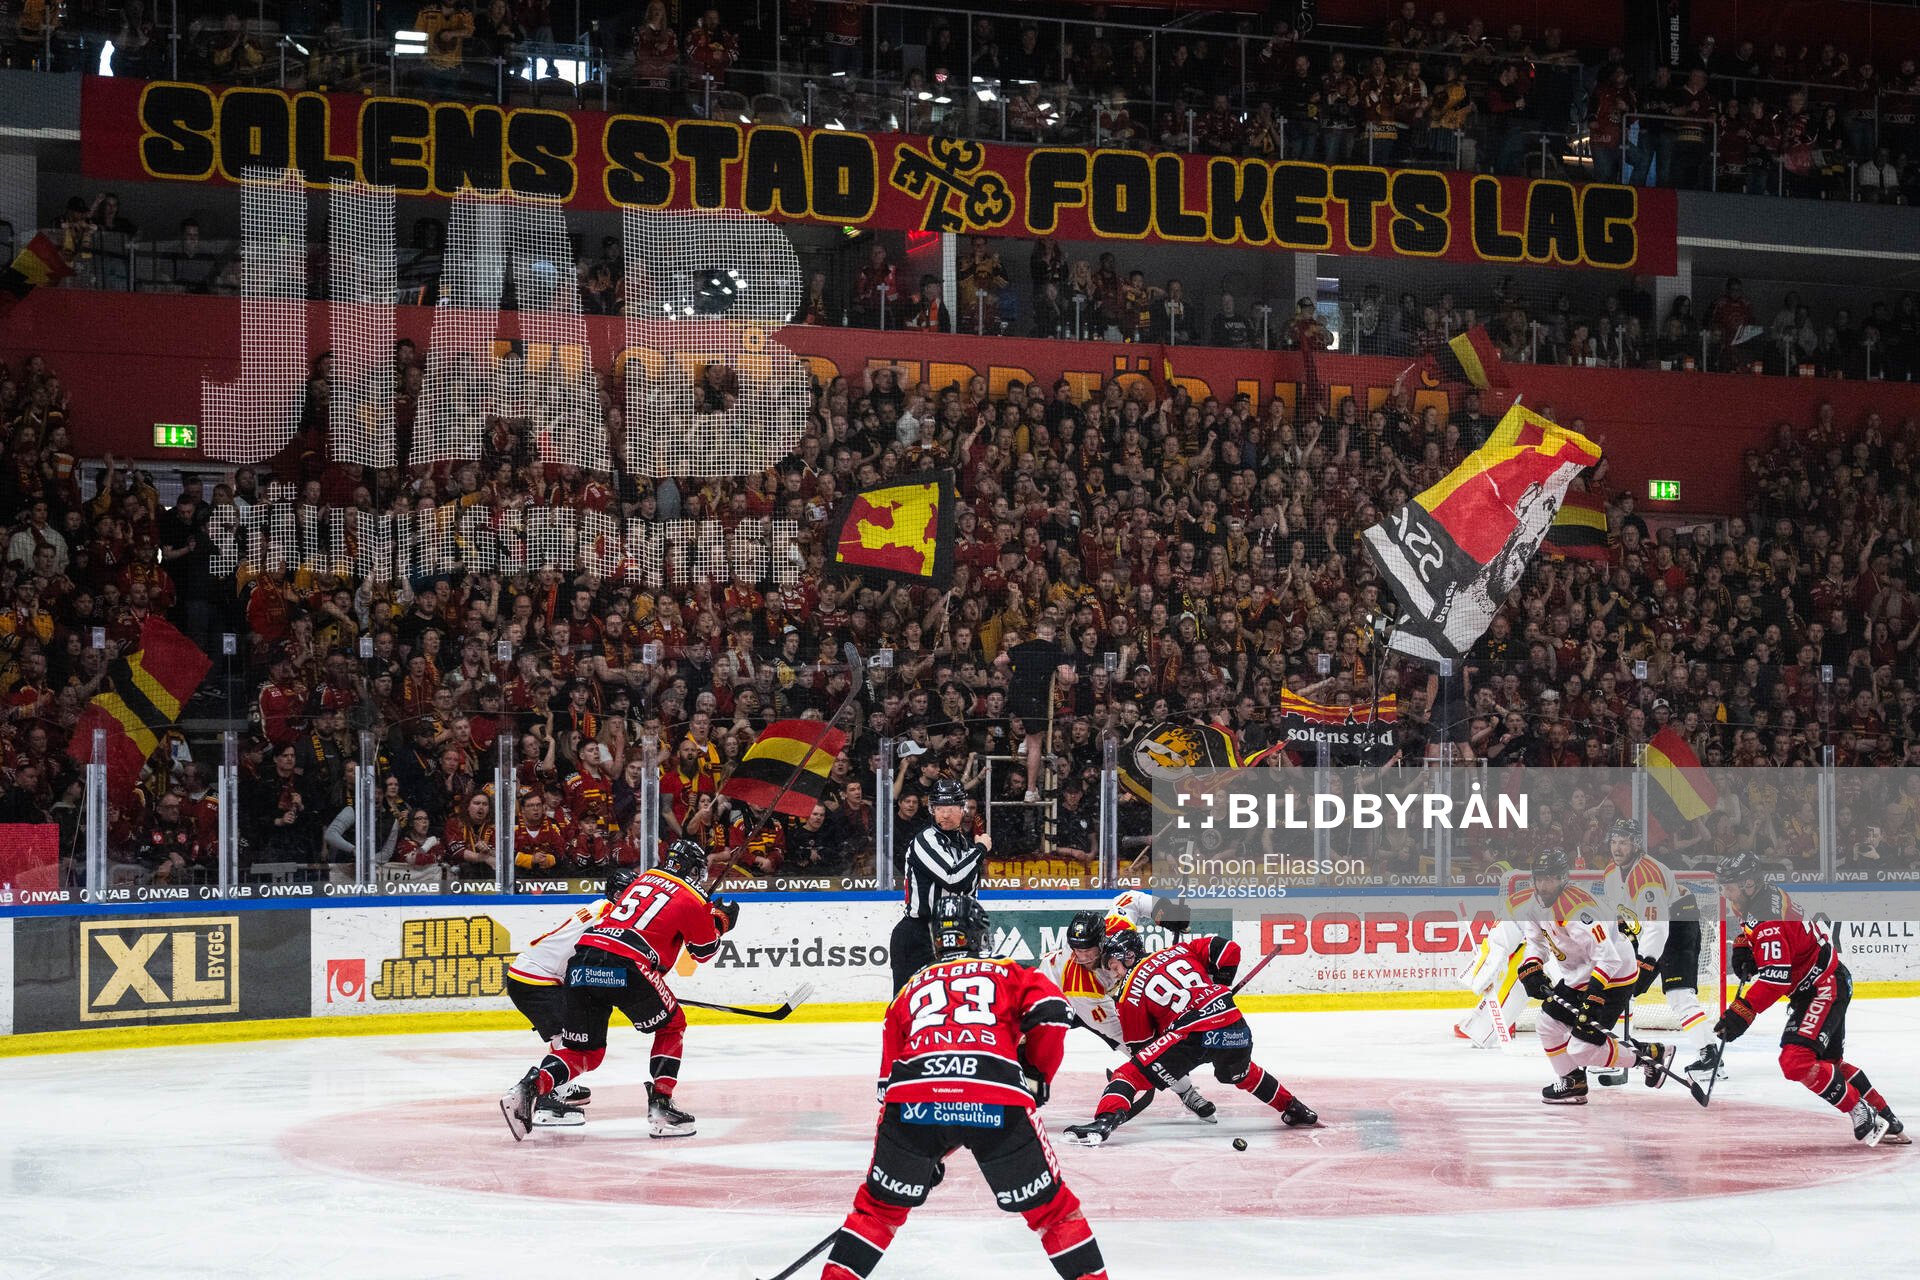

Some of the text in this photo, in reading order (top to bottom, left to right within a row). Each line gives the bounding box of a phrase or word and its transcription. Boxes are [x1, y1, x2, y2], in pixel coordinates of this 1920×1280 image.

[138, 81, 1638, 268] SOLENS STAD FOLKETS LAG
[1287, 728, 1394, 746] solens sd
[1040, 877, 1080, 887] NYAB
[1221, 876, 1259, 886] NYAB
[1279, 876, 1316, 885] NYAB
[1346, 875, 1383, 885] NYAB
[1401, 875, 1438, 884] NYAB
[1764, 873, 1785, 882] YAB
[1801, 872, 1824, 882] NYA
[1835, 872, 1868, 881] NYAB
[1887, 871, 1920, 881] NYAB
[398, 882, 440, 893] NYAB
[525, 881, 568, 891] NYAB
[639, 874, 680, 895] NURMI
[725, 879, 768, 890] NYAB
[788, 879, 831, 889] NYAB
[980, 877, 1021, 888] NYAB
[32, 888, 70, 901] NYAB
[149, 887, 190, 899] NYAB
[272, 885, 313, 895] NYAB
[336, 884, 378, 894] NYAB
[609, 884, 671, 931] 51
[1644, 906, 1658, 921] 45
[1261, 911, 1496, 956] BORGA
[1850, 921, 1914, 938] WALL
[403, 917, 493, 958] EURO
[942, 934, 956, 947] 23
[207, 931, 225, 978] BYGG
[714, 937, 888, 968] Arvidsso
[1760, 940, 1782, 961] 76
[1851, 944, 1908, 954] SECURITY
[91, 931, 225, 1006] XL
[585, 968, 614, 978] Student
[1318, 966, 1458, 980] BYGG BEKYMMERSFRITT
[1766, 968, 1789, 980] LKAB
[585, 976, 626, 987] Consulting
[1144, 959, 1208, 1014] 96
[909, 976, 997, 1037] 23
[643, 1009, 668, 1029] LKAB
[565, 1032, 589, 1043] LKAB
[910, 1029, 997, 1050] VINAB
[921, 1056, 978, 1076] SSAB
[933, 1101, 984, 1112] Student
[933, 1110, 1001, 1126] Consulting
[880, 1175, 924, 1198] LKAB
[1013, 1169, 1052, 1203] LKAB
